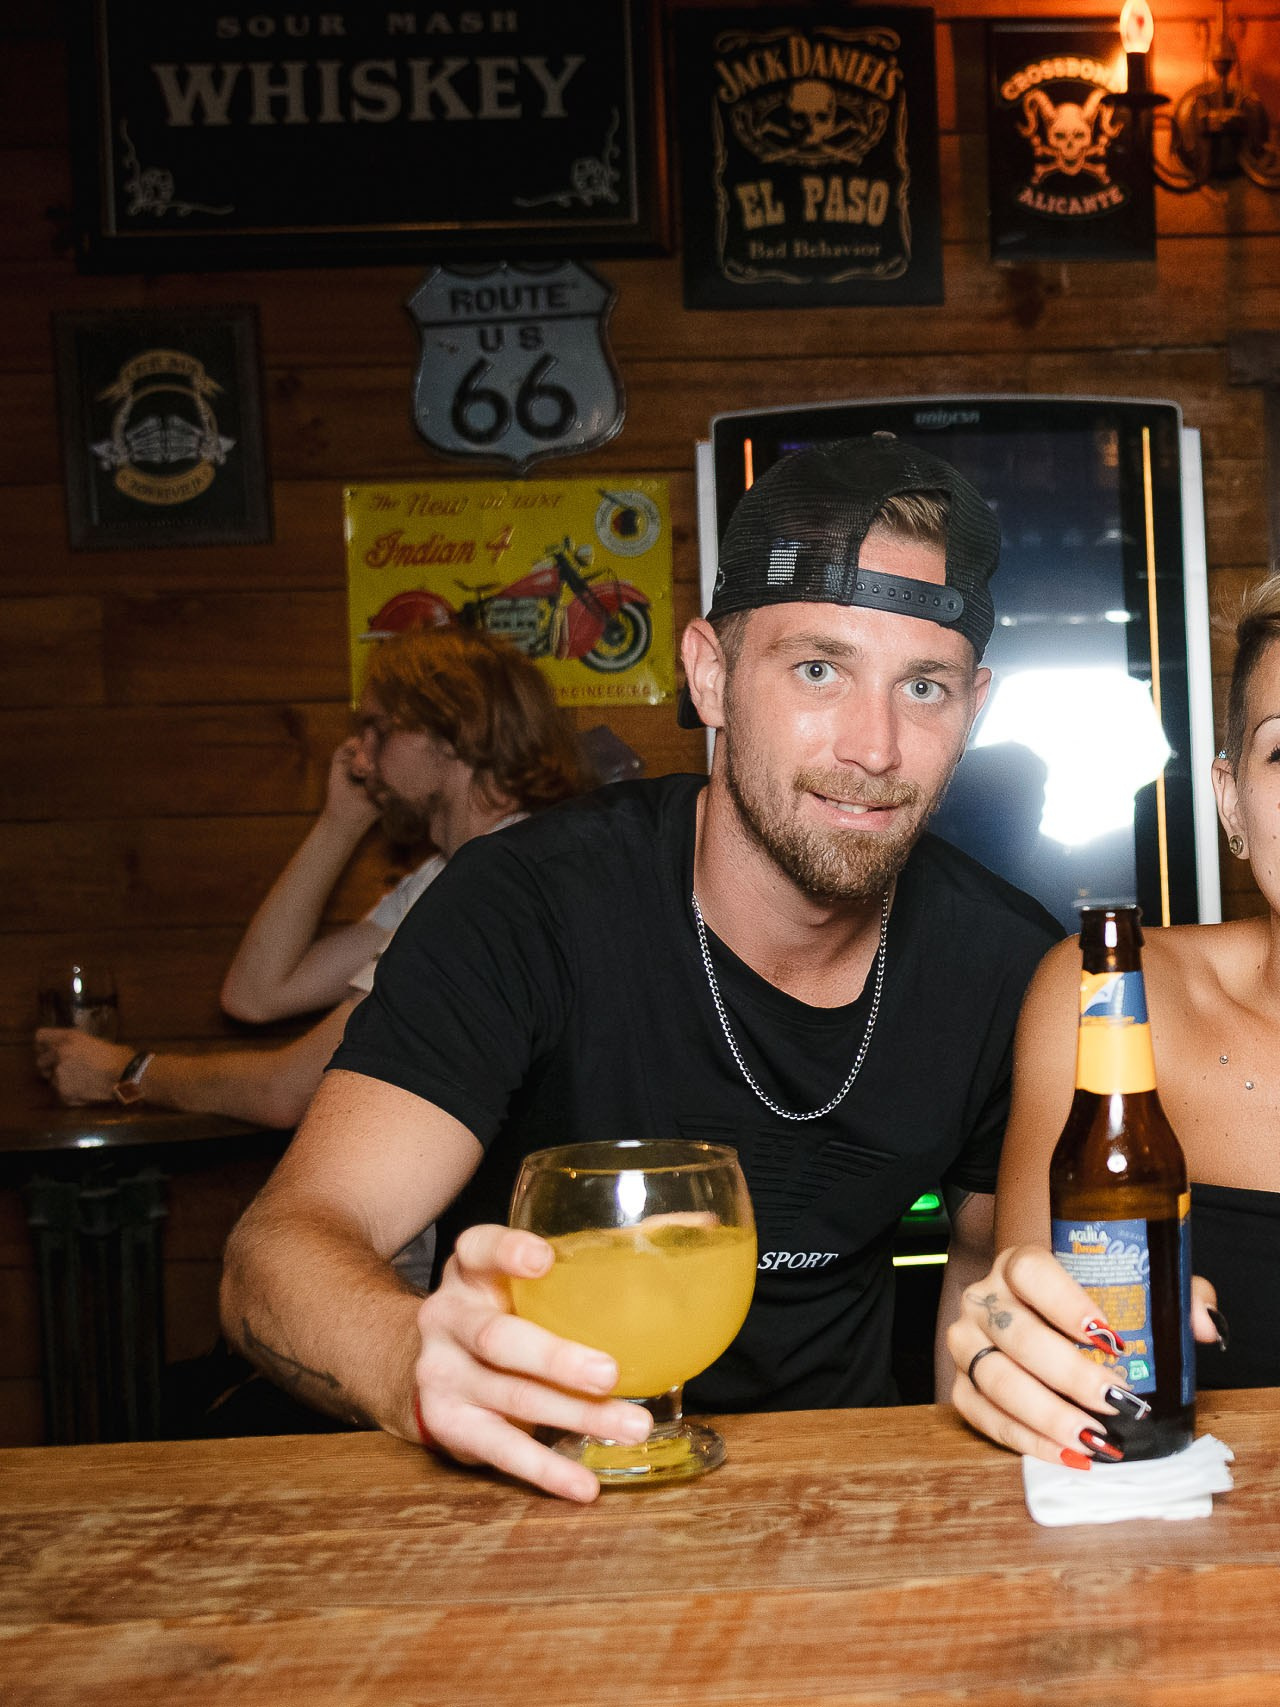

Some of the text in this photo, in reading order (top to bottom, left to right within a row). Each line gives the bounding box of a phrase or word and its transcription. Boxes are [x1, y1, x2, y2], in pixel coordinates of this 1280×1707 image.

[215, 8, 520, 39] SOUR MASH
[714, 34, 904, 103] JACK DANIEL'S
[149, 52, 588, 127] WHISKEY
[736, 174, 890, 231] EL PASO
[1018, 185, 1124, 215] ALICANTE
[751, 240, 881, 259] Bad Behavior
[451, 285, 570, 315] ROUTE
[479, 326, 544, 353] U S
[453, 353, 578, 446] 66
[369, 492, 400, 511] The
[405, 490, 469, 517] New
[365, 523, 515, 569] Indian 4
[757, 1252, 840, 1270] SPORT
